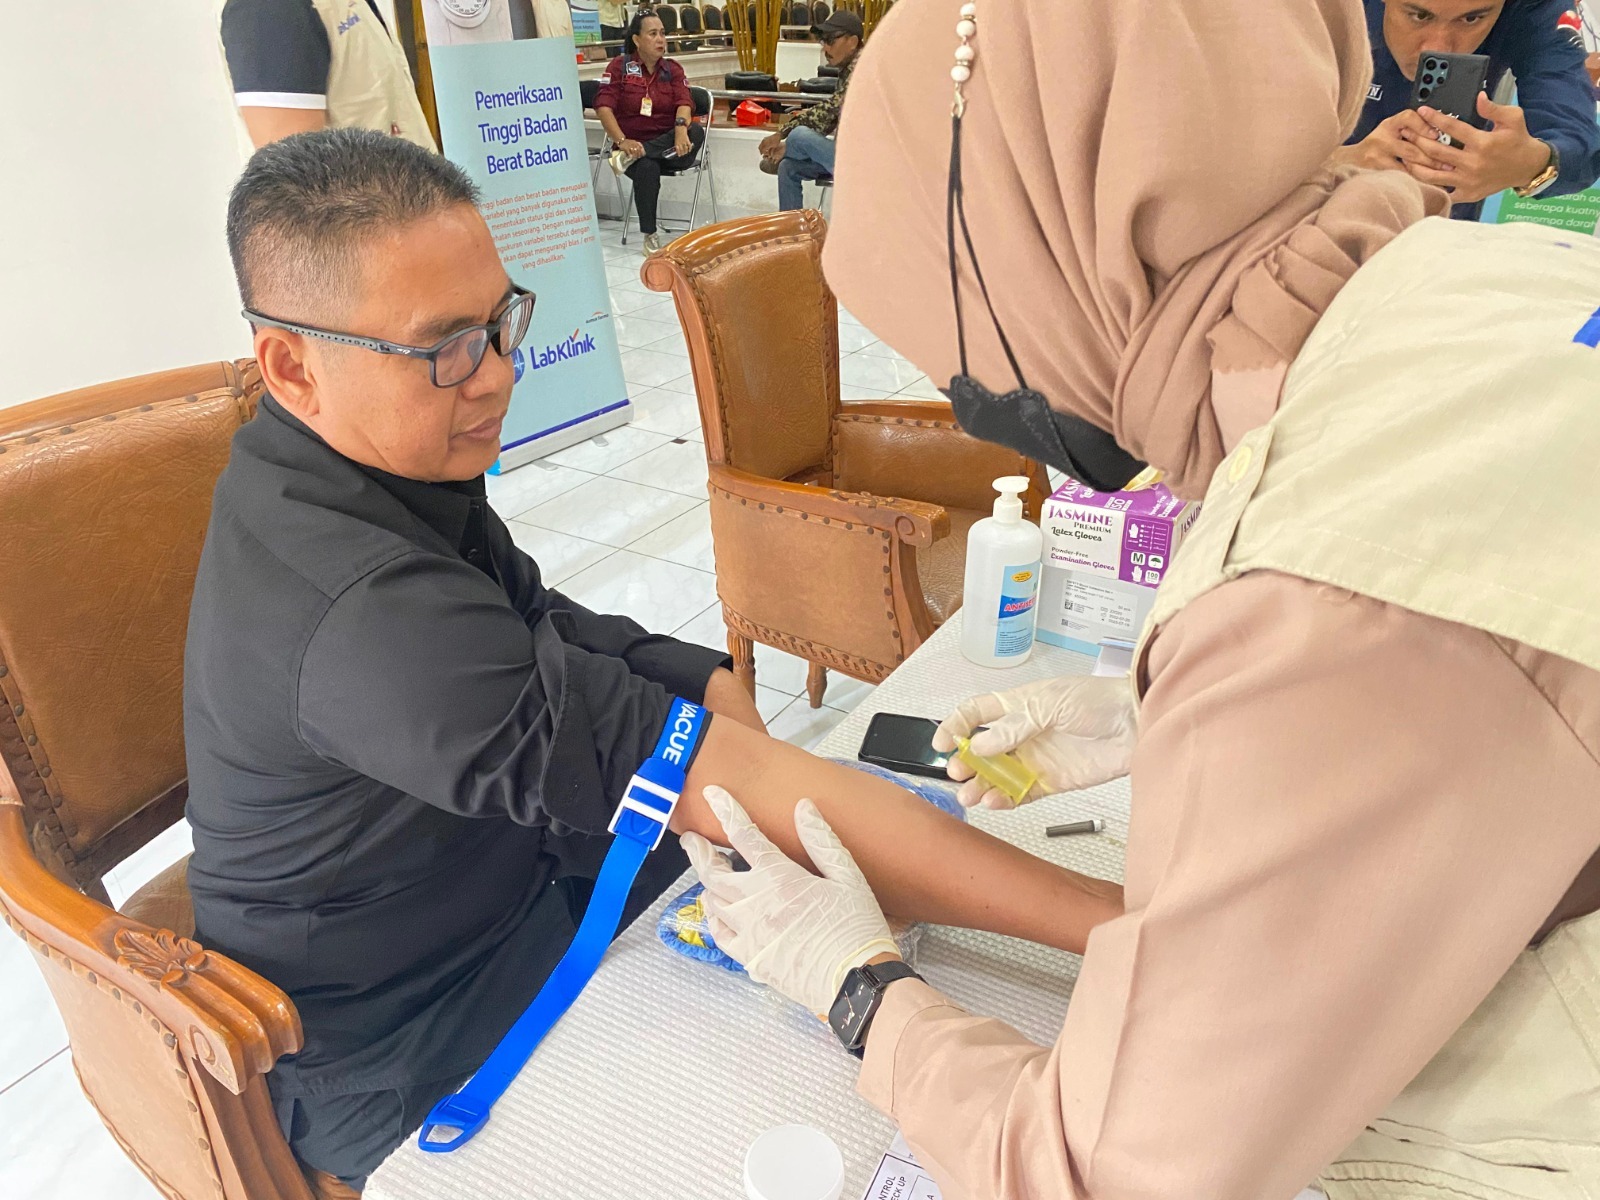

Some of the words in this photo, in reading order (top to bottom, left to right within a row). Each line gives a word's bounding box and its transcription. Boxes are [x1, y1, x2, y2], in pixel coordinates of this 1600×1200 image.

[475, 85, 563, 111] Pemeriksaan
[478, 118, 522, 145] Tinggi
[523, 114, 568, 136] Badan
[486, 151, 524, 175] Berat
[525, 145, 569, 167] Badan
[496, 197, 514, 206] badan
[514, 194, 525, 203] dan
[525, 191, 541, 200] berat
[541, 187, 560, 197] badan
[1514, 201, 1564, 213] seberapa
[1565, 205, 1600, 217] kuatny
[1505, 213, 1564, 226] memompa
[530, 331, 596, 370] LabKlinik
[1049, 504, 1113, 527] JASMINE
[1051, 526, 1074, 537] Latex
[1074, 530, 1103, 542] Gloves
[1074, 521, 1112, 534] PREMIUM
[1051, 546, 1089, 559] Powder-Free
[1133, 552, 1144, 564] M
[1050, 552, 1092, 567] Examination
[1092, 561, 1115, 571] Gloves
[897, 1176, 907, 1187] UP
